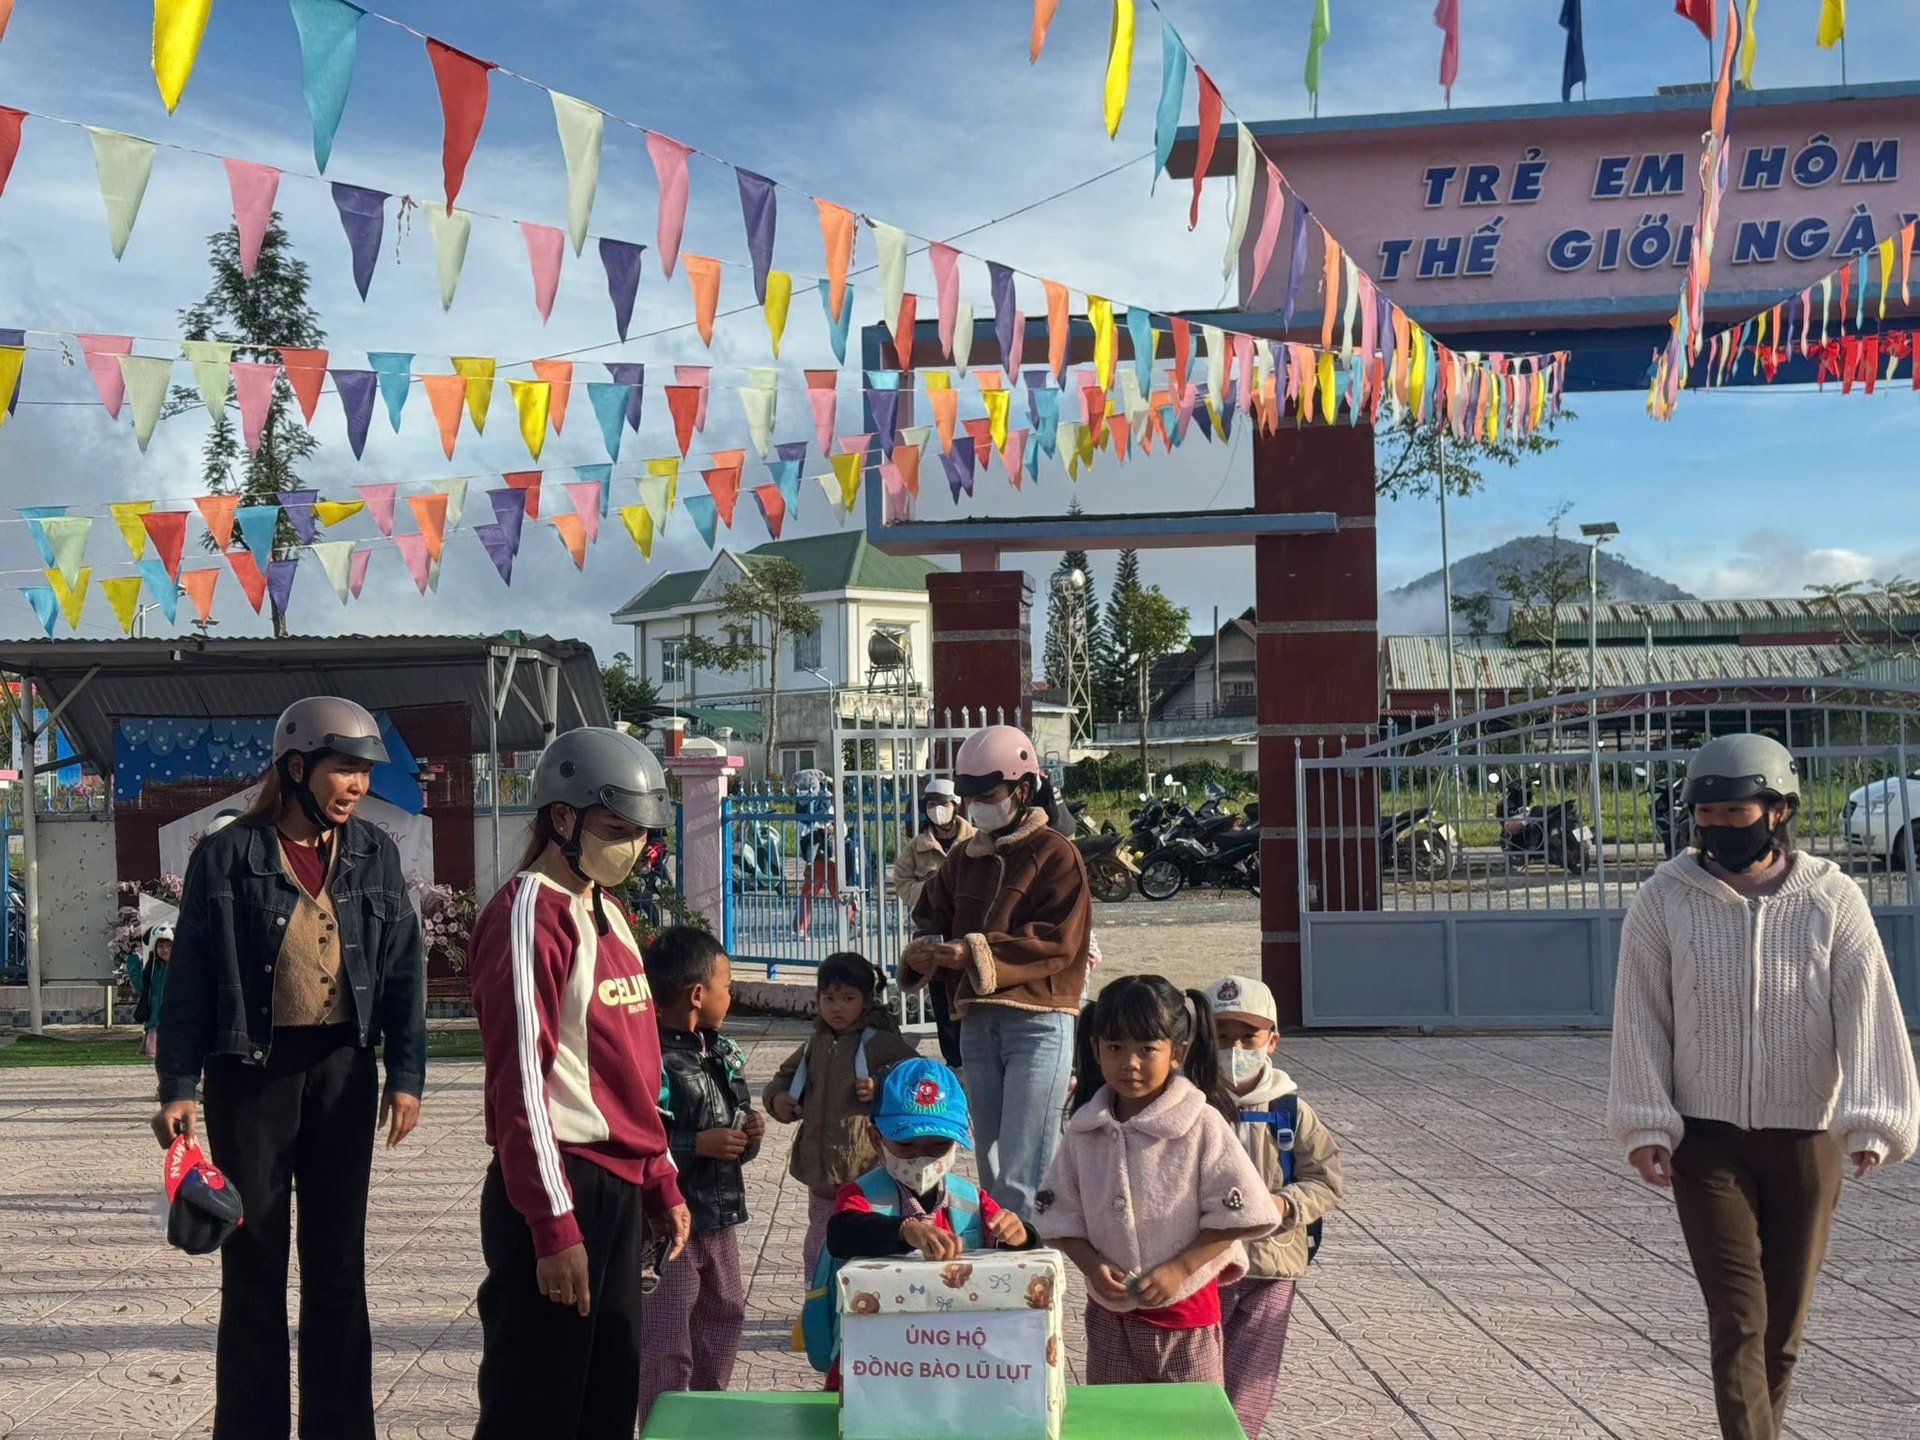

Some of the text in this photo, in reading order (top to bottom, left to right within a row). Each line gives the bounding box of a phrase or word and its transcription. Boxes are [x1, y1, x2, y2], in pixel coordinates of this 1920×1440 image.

[1422, 132, 1899, 207] TRẺ EM HÔM
[1378, 215, 1504, 281] THẾ
[170, 1140, 186, 1178] MAN
[905, 1324, 987, 1350] ỦNG HỘ
[852, 1354, 1033, 1383] ĐỒNG BÀO LŨ LỤT
